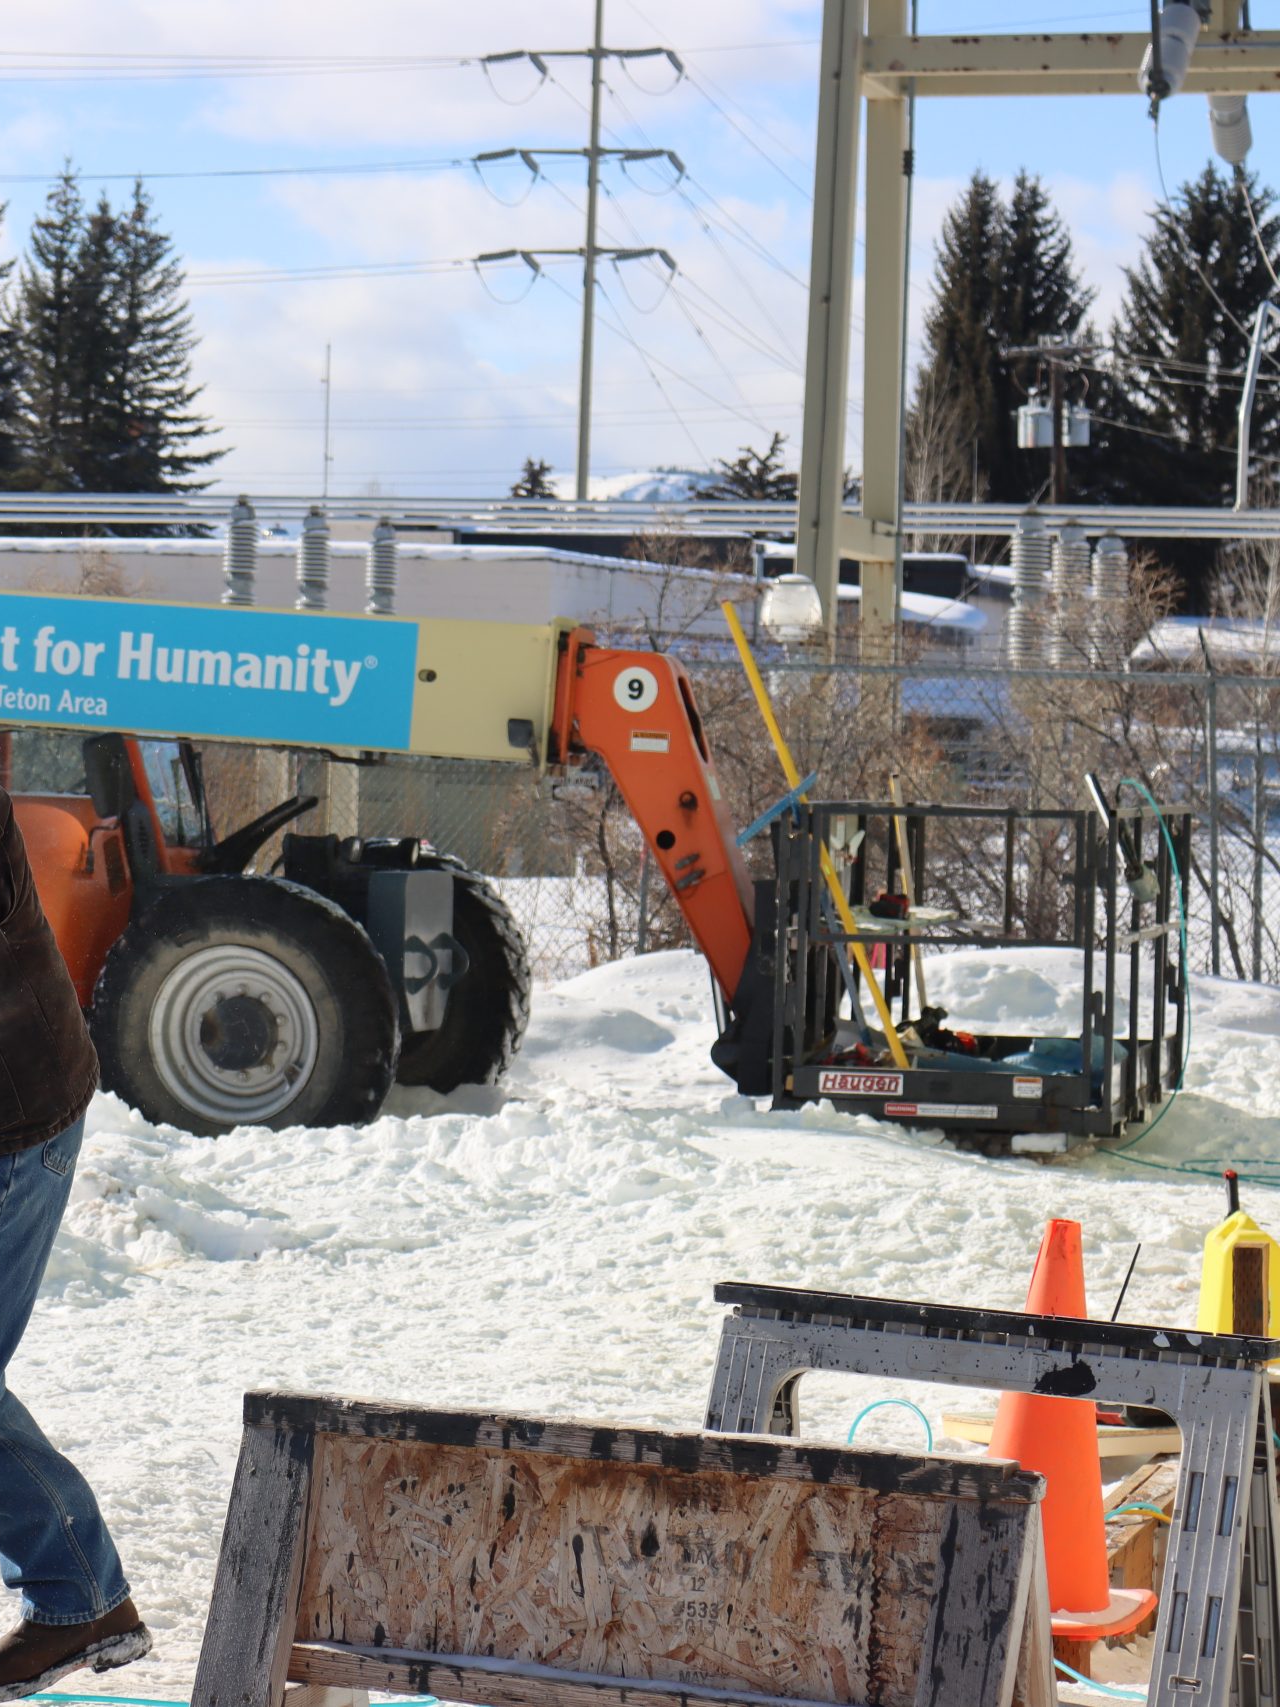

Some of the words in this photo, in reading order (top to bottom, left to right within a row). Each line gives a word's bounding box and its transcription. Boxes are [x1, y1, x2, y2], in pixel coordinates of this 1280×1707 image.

[33, 625, 106, 677] for
[627, 678, 644, 700] 9
[57, 689, 108, 716] Area
[690, 1576, 706, 1592] 12
